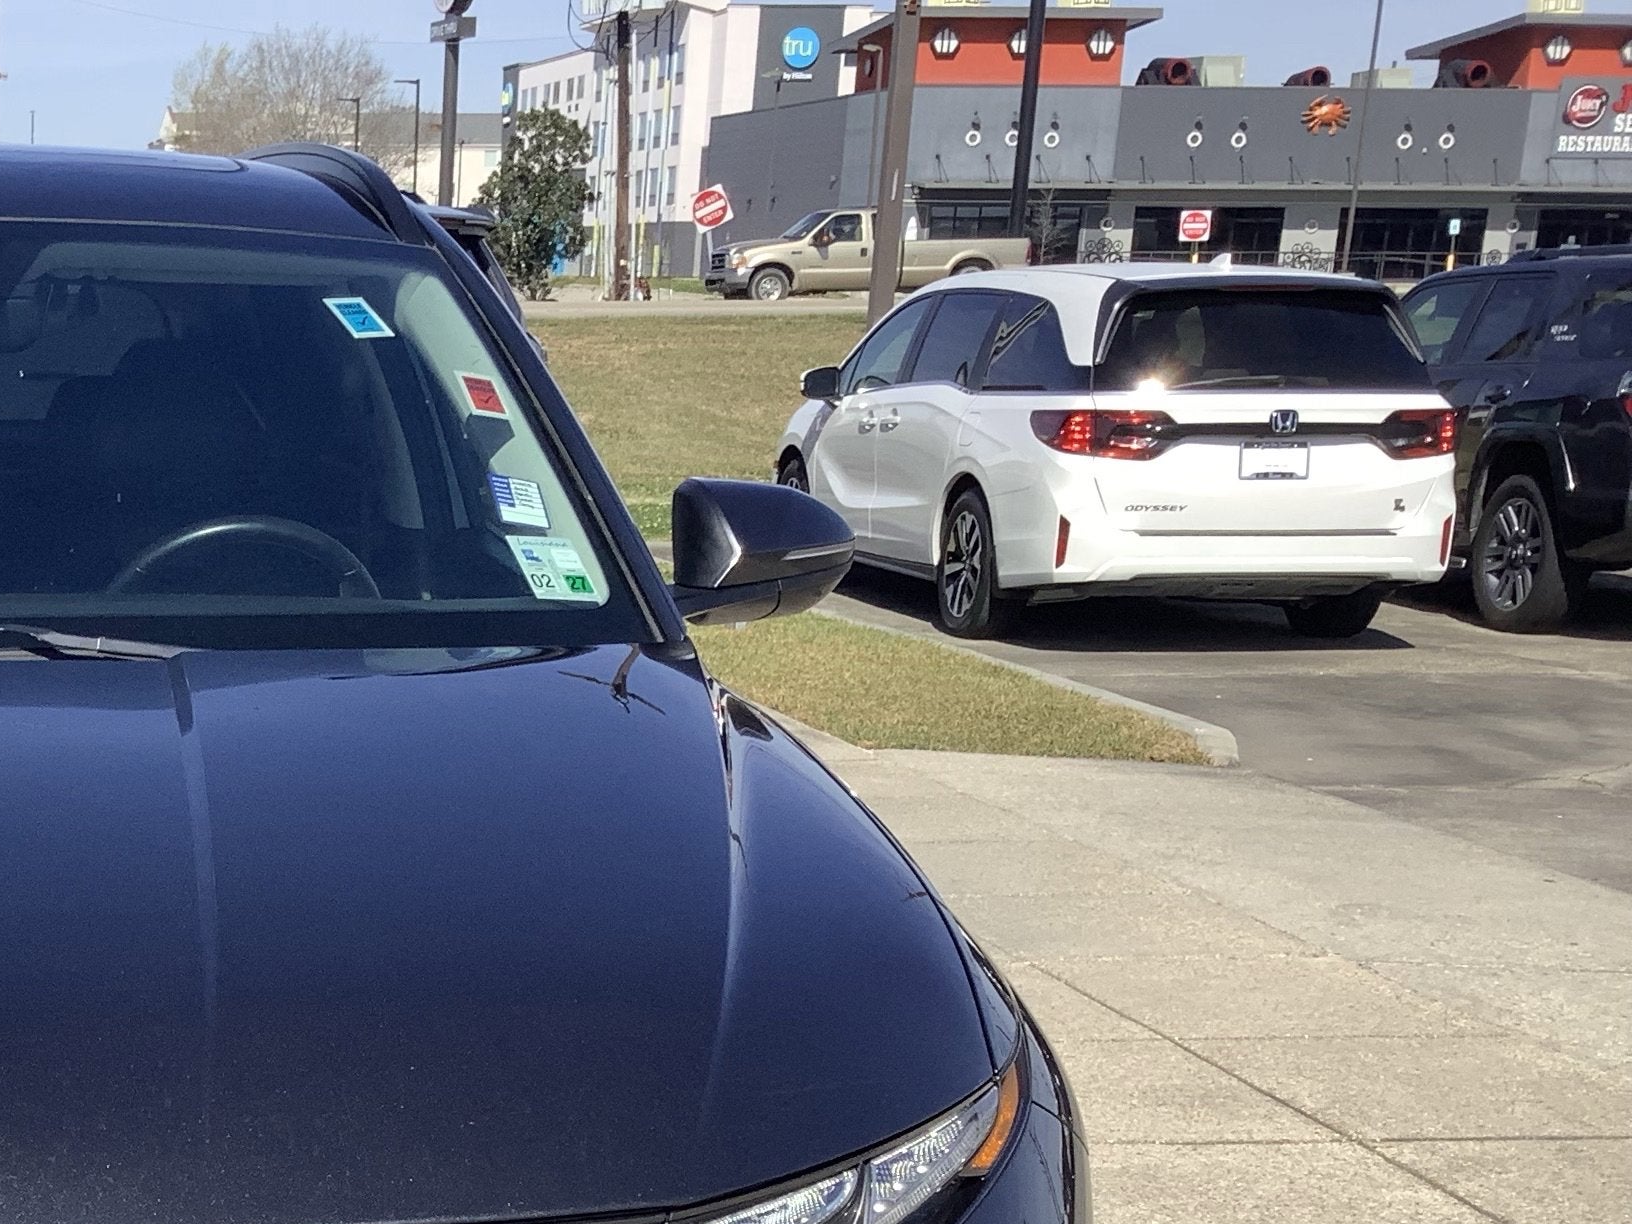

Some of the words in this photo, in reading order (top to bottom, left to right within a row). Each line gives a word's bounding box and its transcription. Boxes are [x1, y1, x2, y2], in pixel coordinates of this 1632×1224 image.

[784, 36, 813, 57] tru
[702, 209, 724, 224] ENTER
[1124, 504, 1188, 512] ODYSSEY
[530, 573, 556, 588] 02
[565, 575, 587, 591] 27
